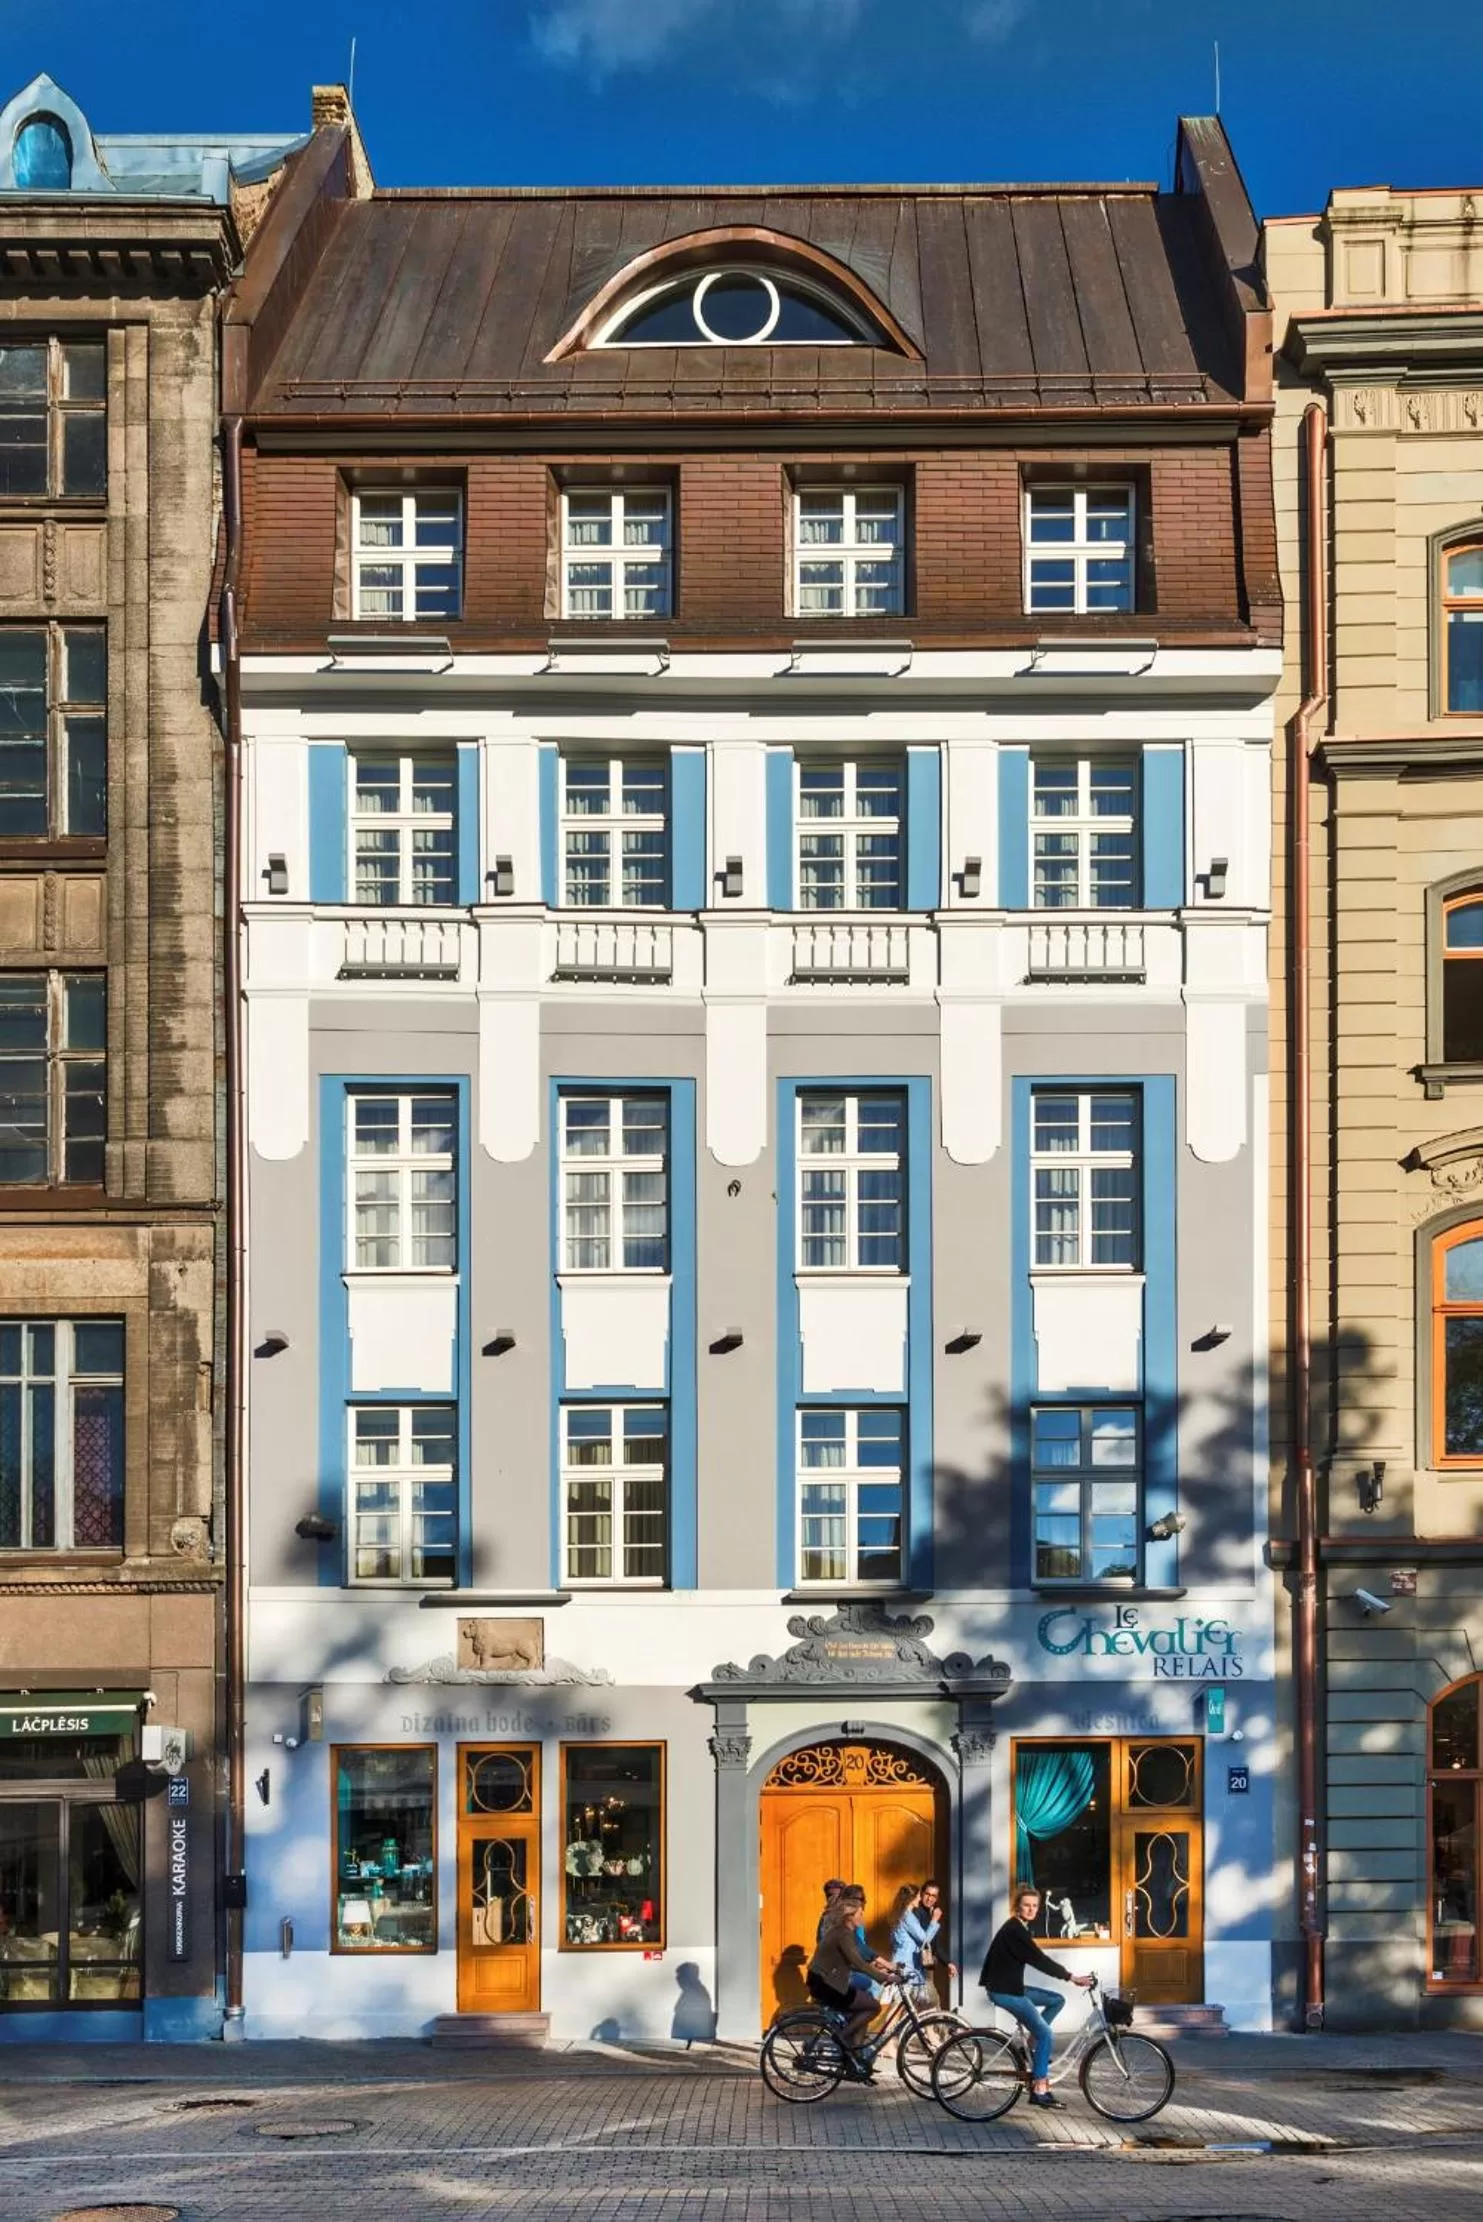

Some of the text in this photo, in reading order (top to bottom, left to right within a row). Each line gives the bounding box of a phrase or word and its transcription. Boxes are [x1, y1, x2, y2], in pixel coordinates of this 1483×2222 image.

[1153, 1657, 1244, 1678] RELAIS
[847, 1754, 865, 1770] 20
[171, 1784, 186, 1797] 22
[1231, 1777, 1247, 1789] 20
[172, 1819, 186, 1896] KARAOKE
